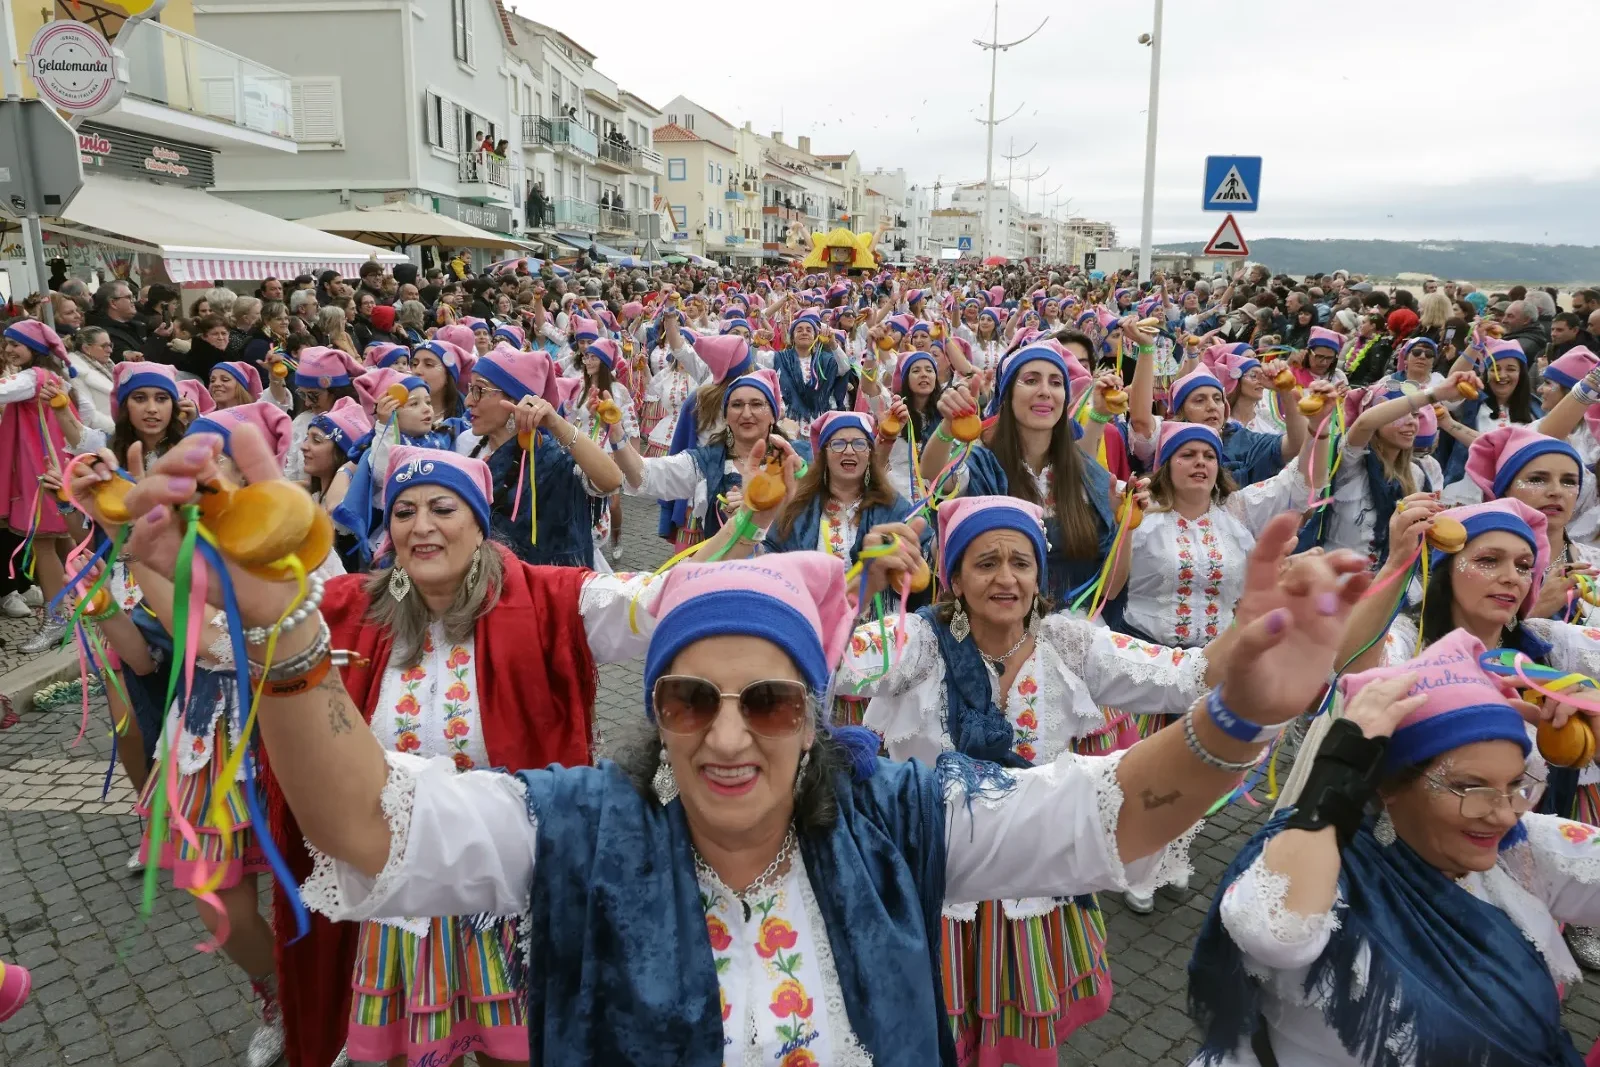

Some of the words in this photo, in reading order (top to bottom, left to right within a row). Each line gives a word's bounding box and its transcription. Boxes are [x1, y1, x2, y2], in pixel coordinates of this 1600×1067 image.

[38, 58, 107, 75] Gelatomania
[78, 84, 99, 99] ITALIANA
[395, 458, 434, 482] M
